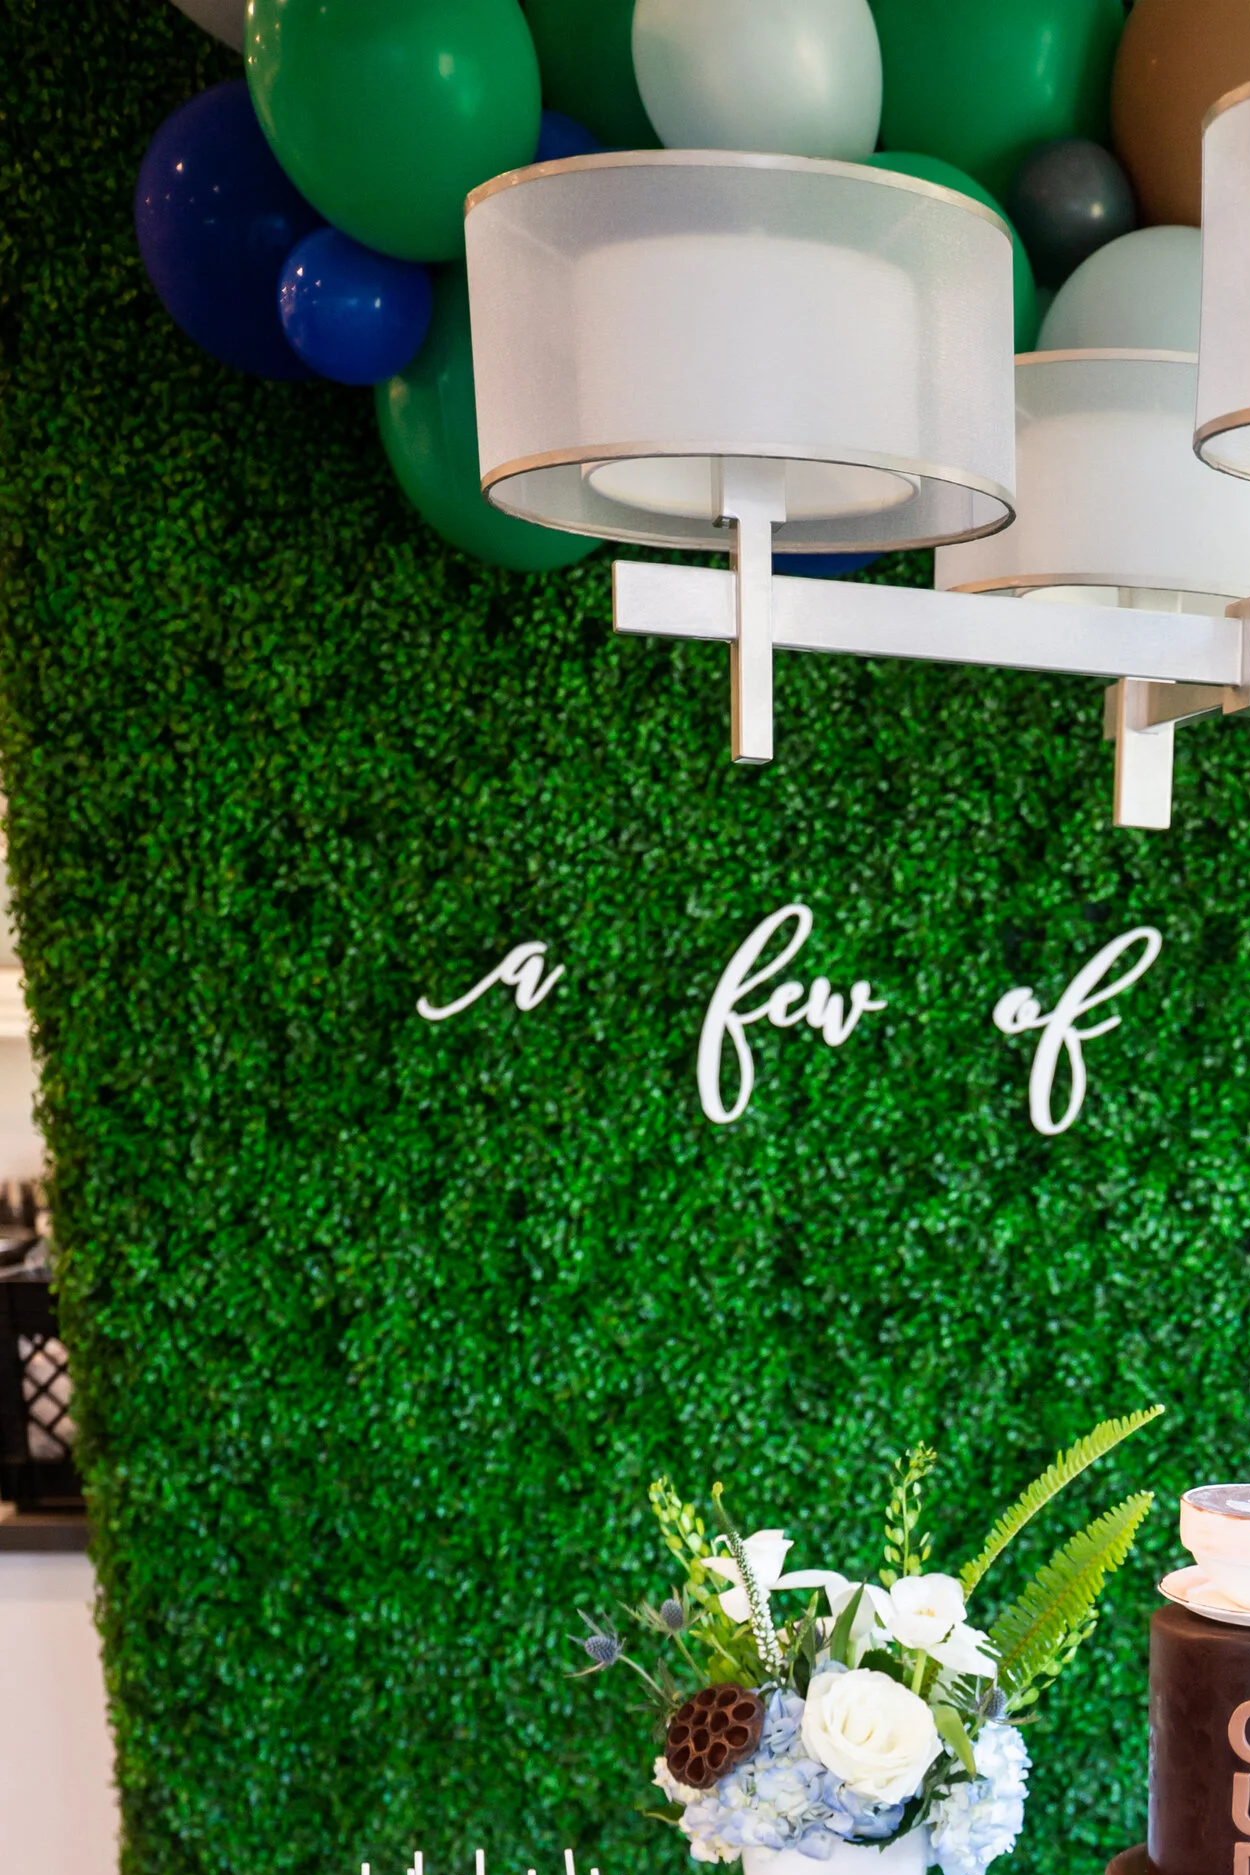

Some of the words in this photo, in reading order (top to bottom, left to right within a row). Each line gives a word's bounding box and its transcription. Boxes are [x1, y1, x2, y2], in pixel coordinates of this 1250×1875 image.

[416, 941, 565, 1021] a
[697, 903, 888, 1125] few
[993, 926, 1163, 1135] of
